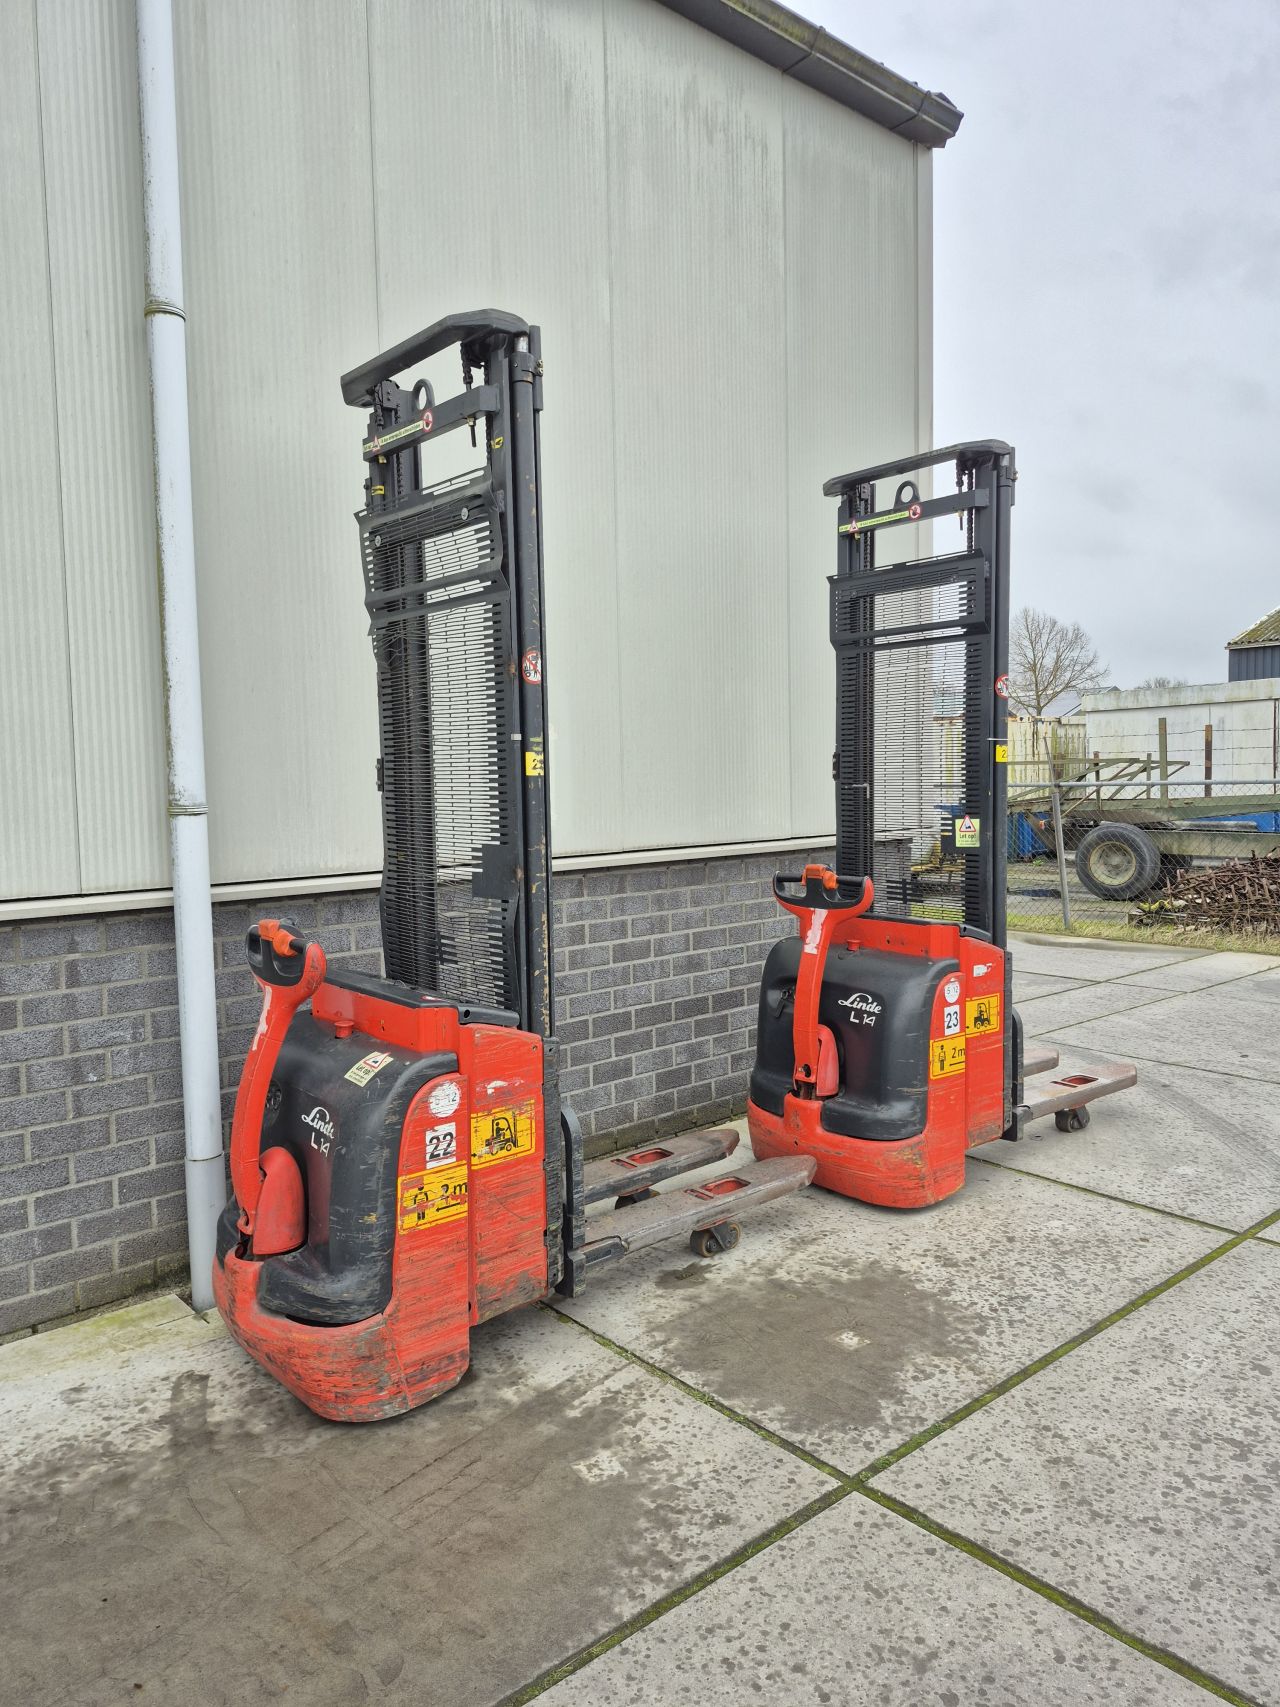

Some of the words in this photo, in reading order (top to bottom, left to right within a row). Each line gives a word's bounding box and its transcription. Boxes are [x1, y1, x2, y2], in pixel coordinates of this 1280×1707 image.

[838, 992, 882, 1014] Linde
[849, 1010, 859, 1023] L
[862, 1013, 876, 1027] 14
[945, 1010, 959, 1030] 23
[951, 1047, 957, 1058] 2
[301, 1106, 335, 1139] Linde
[310, 1131, 318, 1150] L
[429, 1131, 454, 1160] 22
[440, 1183, 450, 1200] 2
[453, 1182, 468, 1195] m
